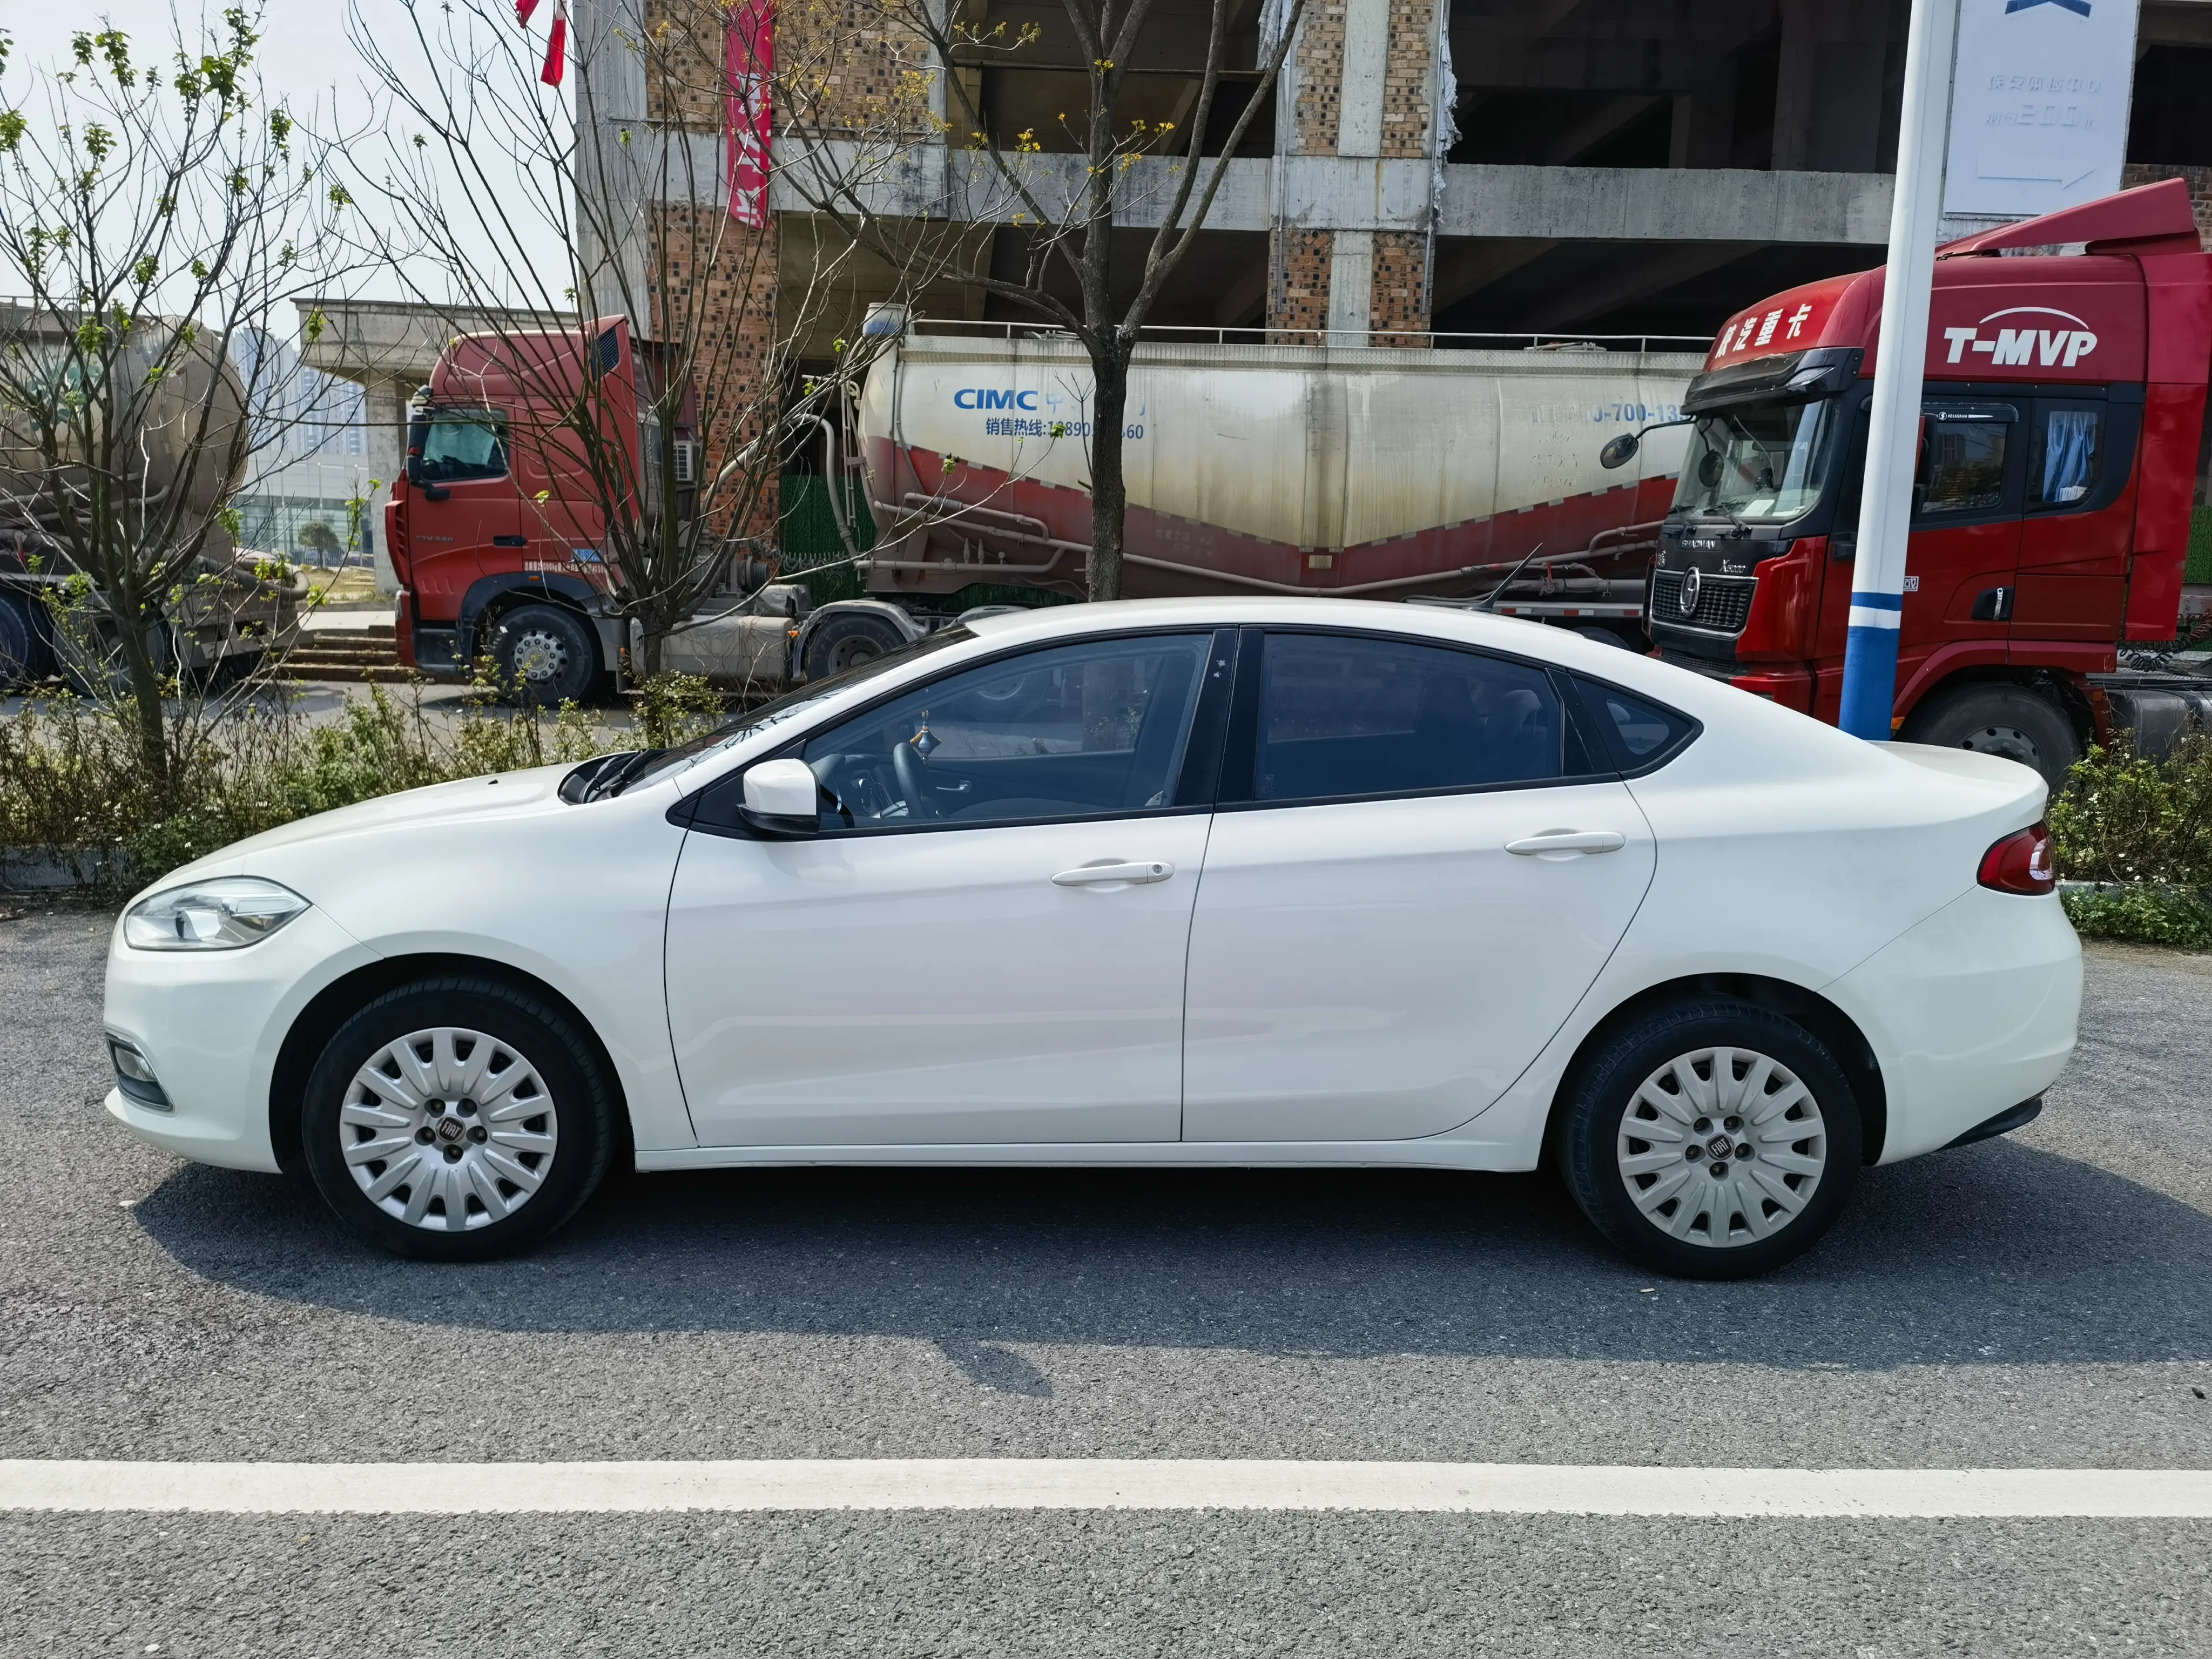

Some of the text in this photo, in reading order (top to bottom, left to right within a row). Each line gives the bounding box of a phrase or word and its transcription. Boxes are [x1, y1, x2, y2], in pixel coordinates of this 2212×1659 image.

[1944, 327, 2098, 367] T-MVP
[954, 389, 1038, 410] CIMC
[441, 1121, 461, 1138] FIAT
[1710, 1138, 1729, 1156] FIAT
